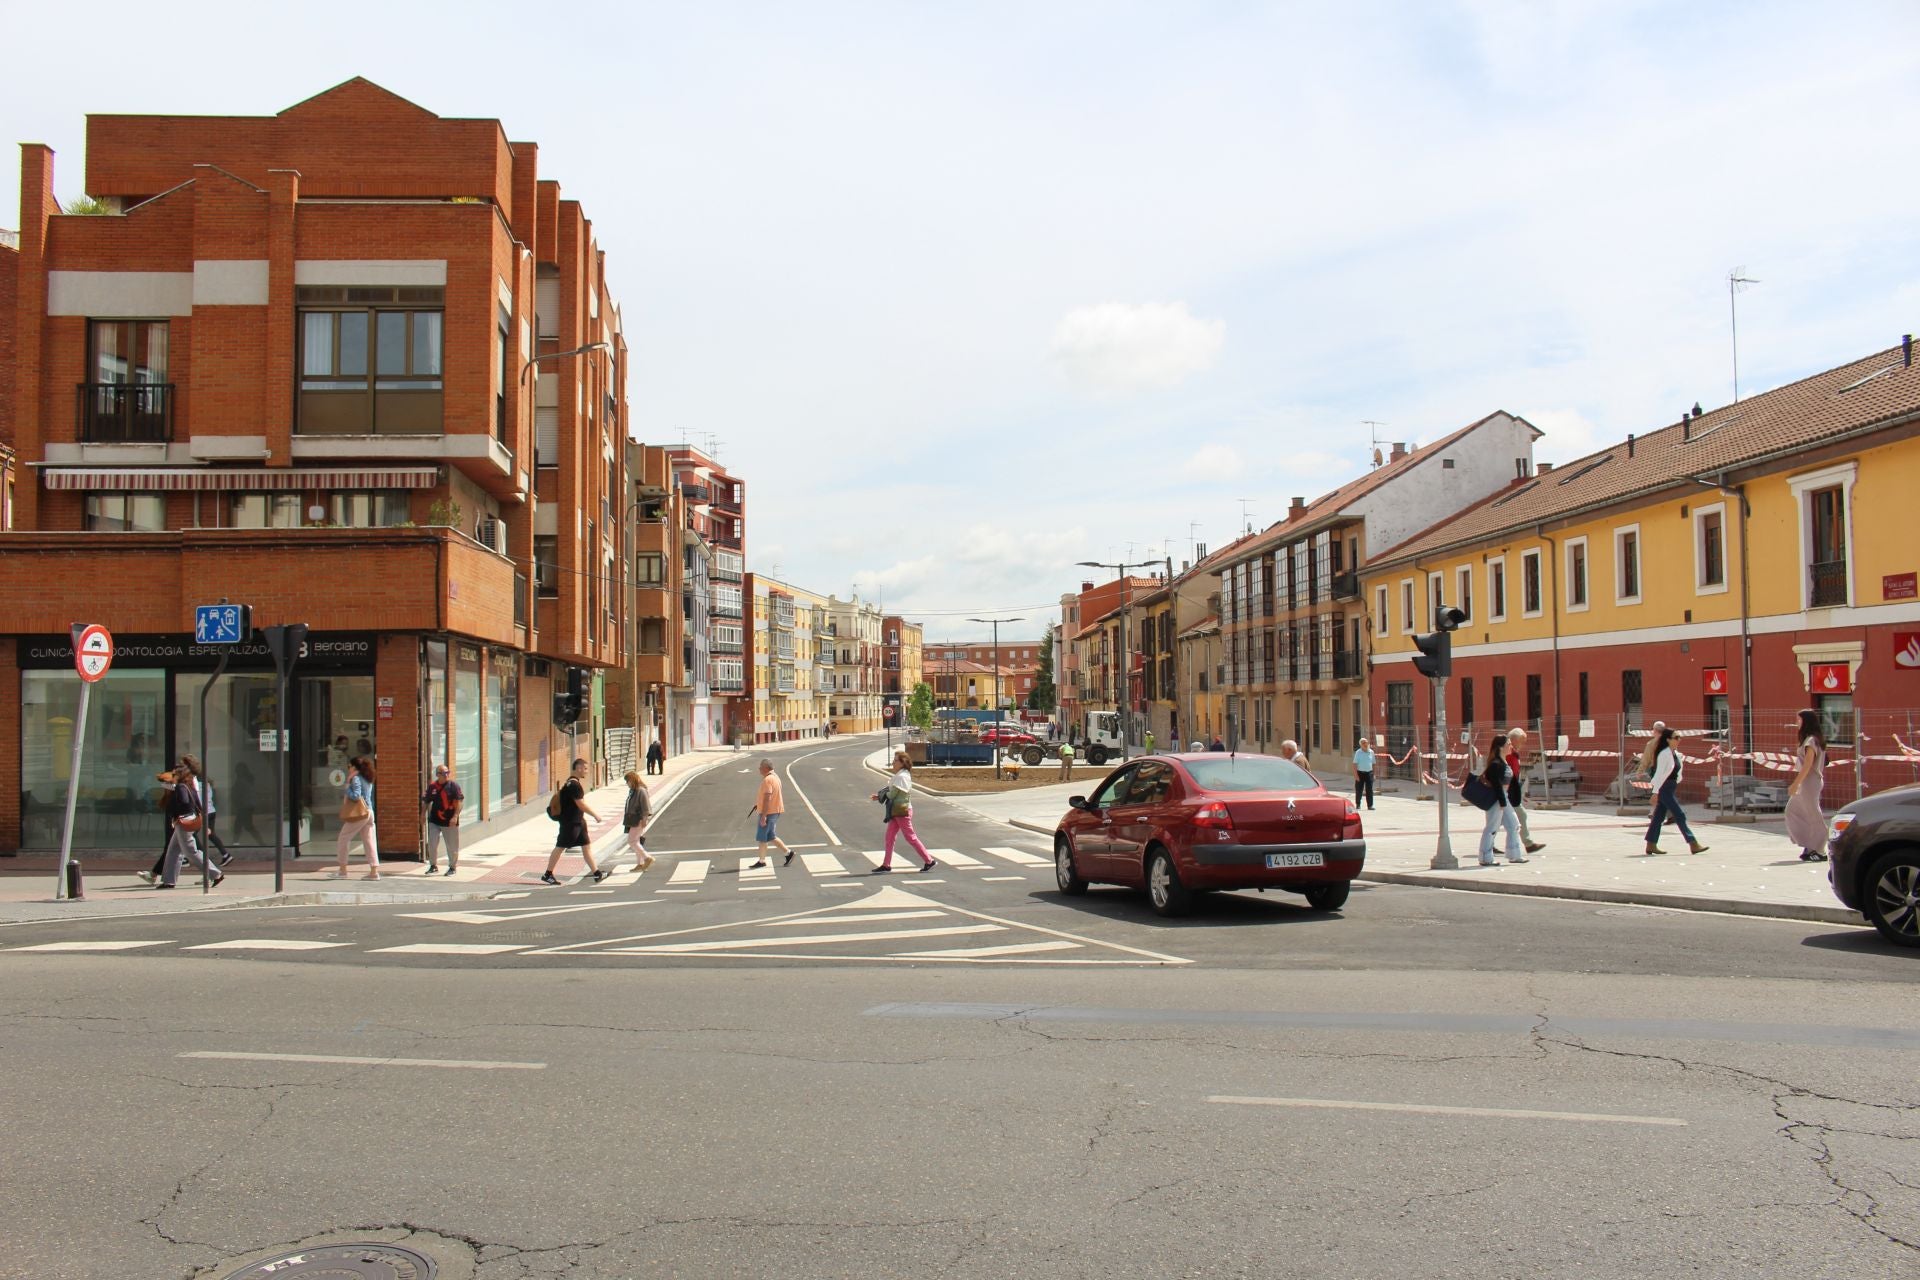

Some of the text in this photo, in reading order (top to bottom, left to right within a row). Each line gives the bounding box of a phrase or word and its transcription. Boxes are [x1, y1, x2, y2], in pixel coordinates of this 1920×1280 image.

[31, 645, 273, 658] CLINICA DONTOLOGIA ESPECALIZADA
[1274, 853, 1321, 866] 4192 CZB
